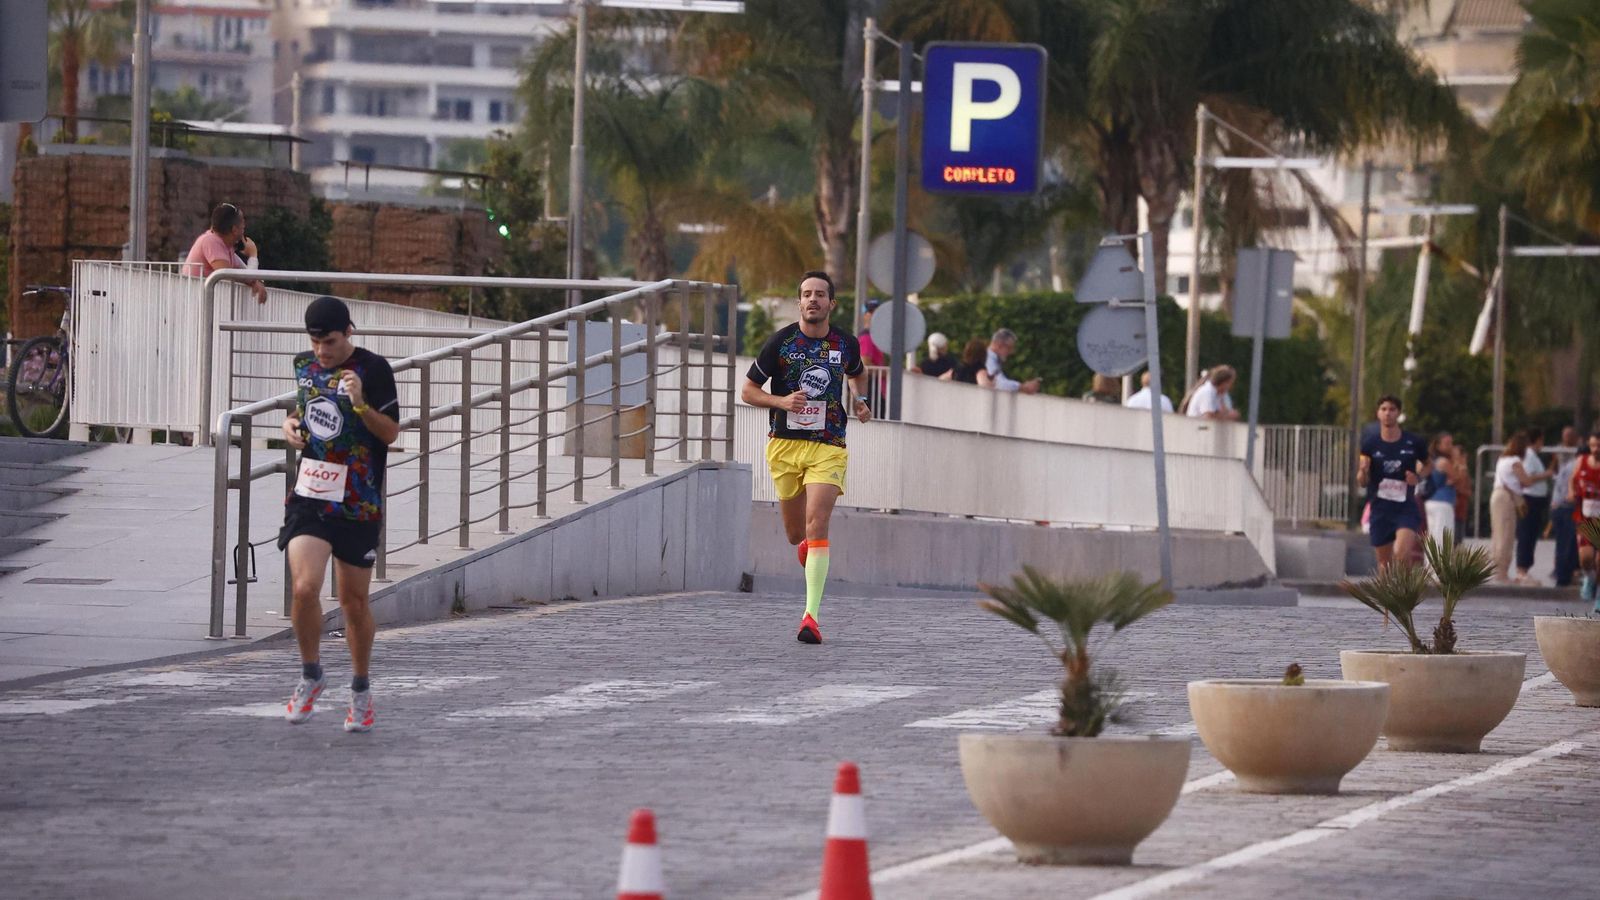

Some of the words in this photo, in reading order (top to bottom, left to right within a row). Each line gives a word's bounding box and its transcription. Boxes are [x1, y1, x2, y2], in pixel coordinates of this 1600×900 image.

[950, 62, 1022, 152] P
[943, 166, 1016, 183] COMPLETO
[802, 379, 825, 391] FRENO
[805, 373, 828, 386] PONLE
[309, 414, 337, 431] FRENO
[310, 405, 339, 424] PONLE
[303, 468, 340, 482] 4407
